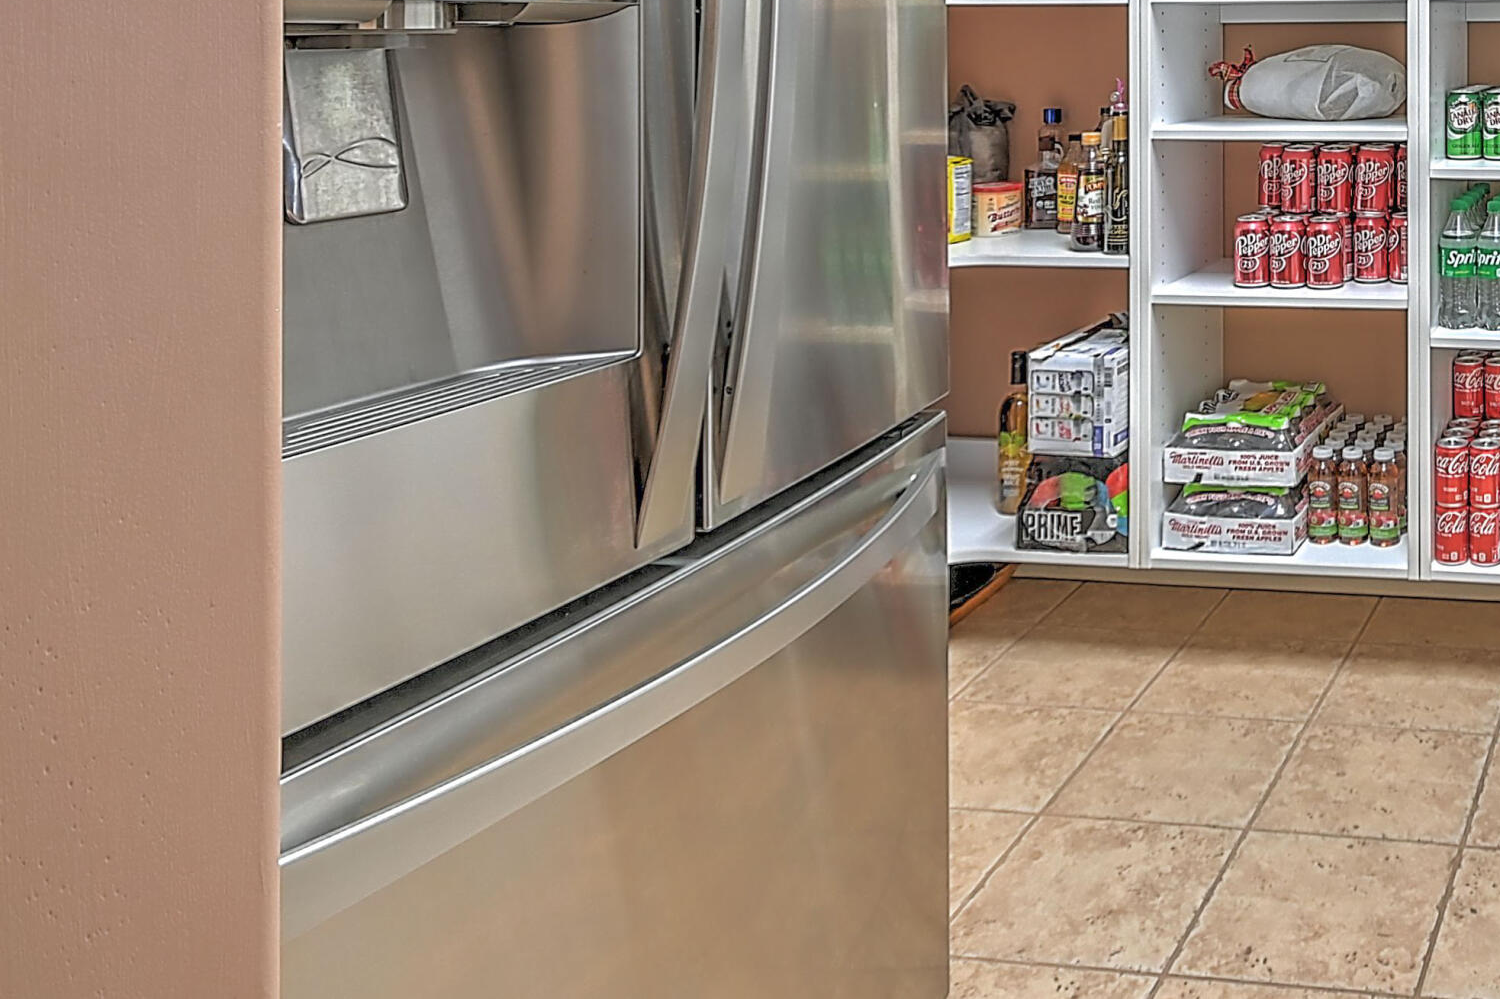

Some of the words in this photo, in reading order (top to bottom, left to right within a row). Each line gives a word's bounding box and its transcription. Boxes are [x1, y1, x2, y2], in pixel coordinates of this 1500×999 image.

[1457, 116, 1474, 126] DRY
[1357, 165, 1389, 184] Pepper
[1248, 231, 1261, 245] Dr
[1317, 232, 1331, 247] Dr
[1363, 229, 1376, 243] Dr
[1237, 236, 1270, 257] Pepper
[1307, 237, 1340, 258] Pepper
[1447, 250, 1475, 268] Spri
[1169, 451, 1224, 467] Martinelli's
[1023, 510, 1082, 541] PRIME
[1168, 518, 1222, 535] Martinelli's
